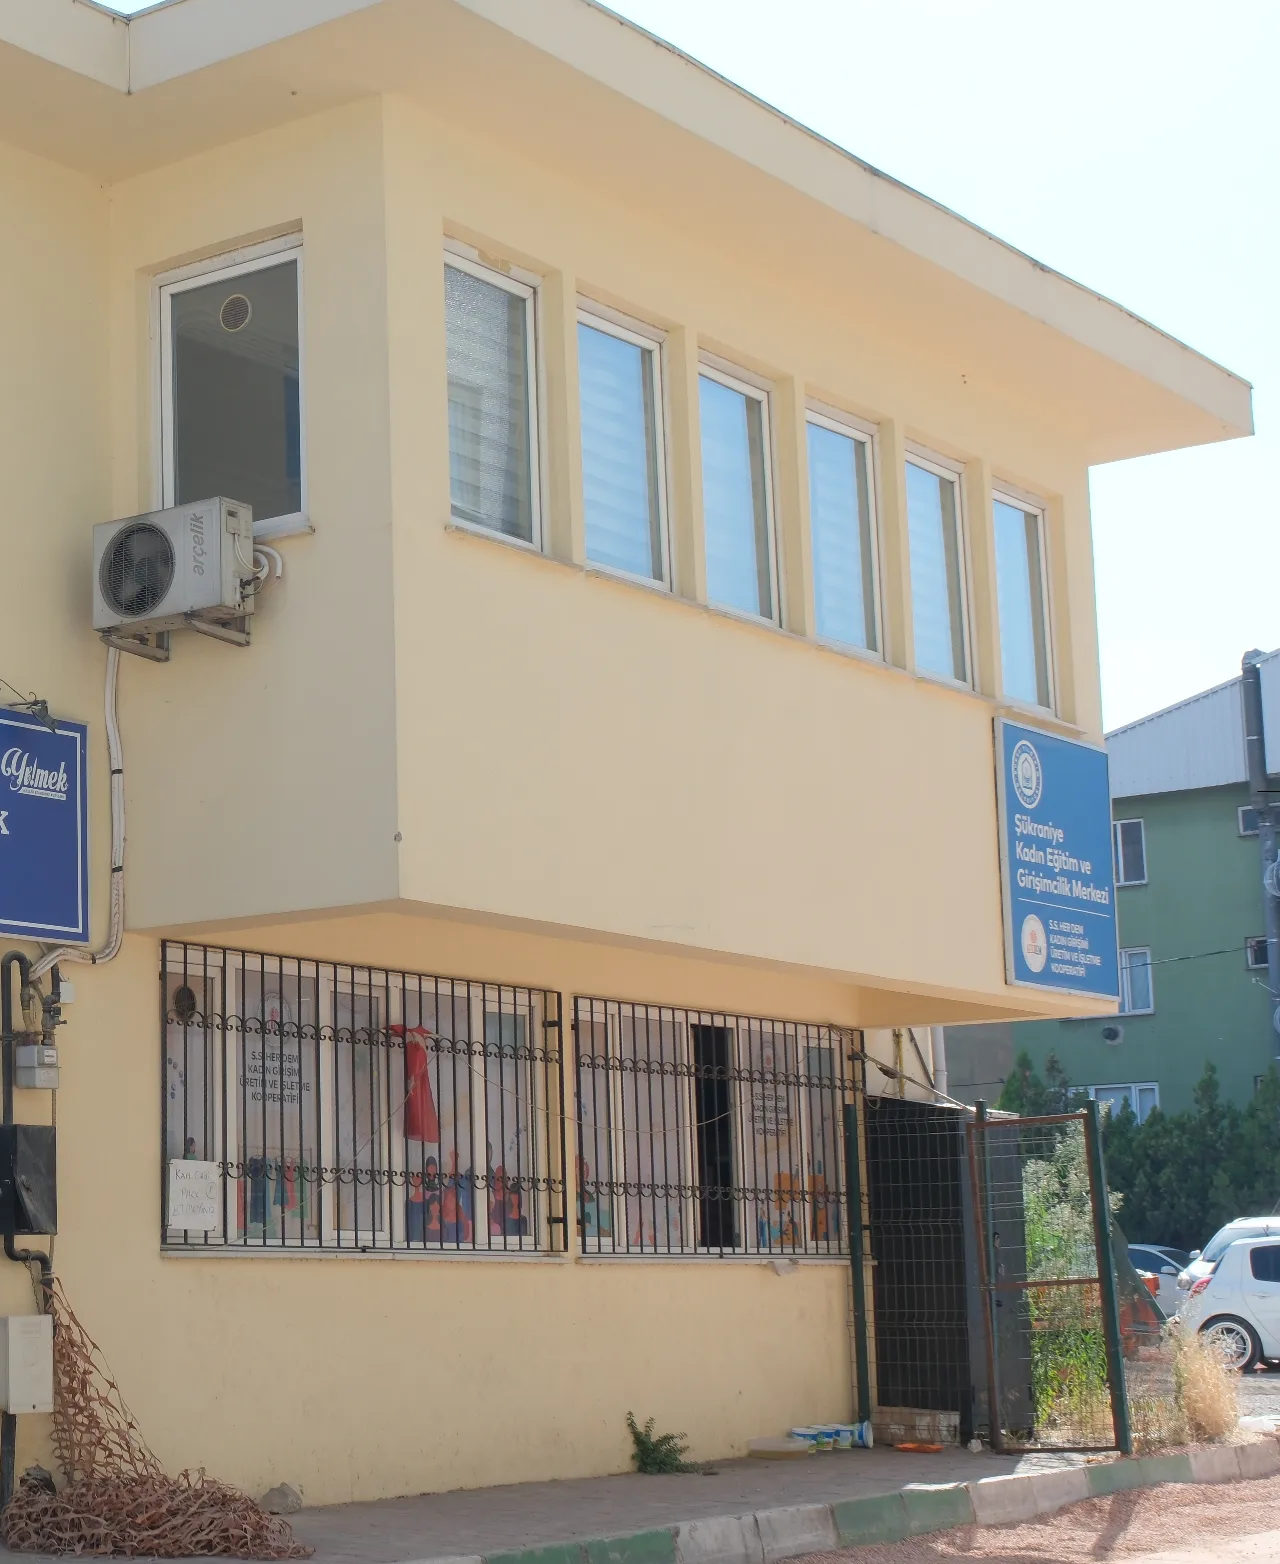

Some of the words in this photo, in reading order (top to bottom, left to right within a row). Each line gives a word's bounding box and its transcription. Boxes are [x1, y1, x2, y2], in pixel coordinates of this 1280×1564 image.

[189, 512, 207, 576] arçelik
[1014, 813, 1064, 846] Şükraniye
[1015, 840, 1045, 865] Kadın
[1046, 847, 1079, 873] Eğitim
[1079, 859, 1092, 875] ve
[1017, 868, 1072, 897] Girişimcilik
[1072, 879, 1110, 905] Merkezi
[247, 1064, 271, 1075] KADN
[268, 1079, 279, 1089] VE
